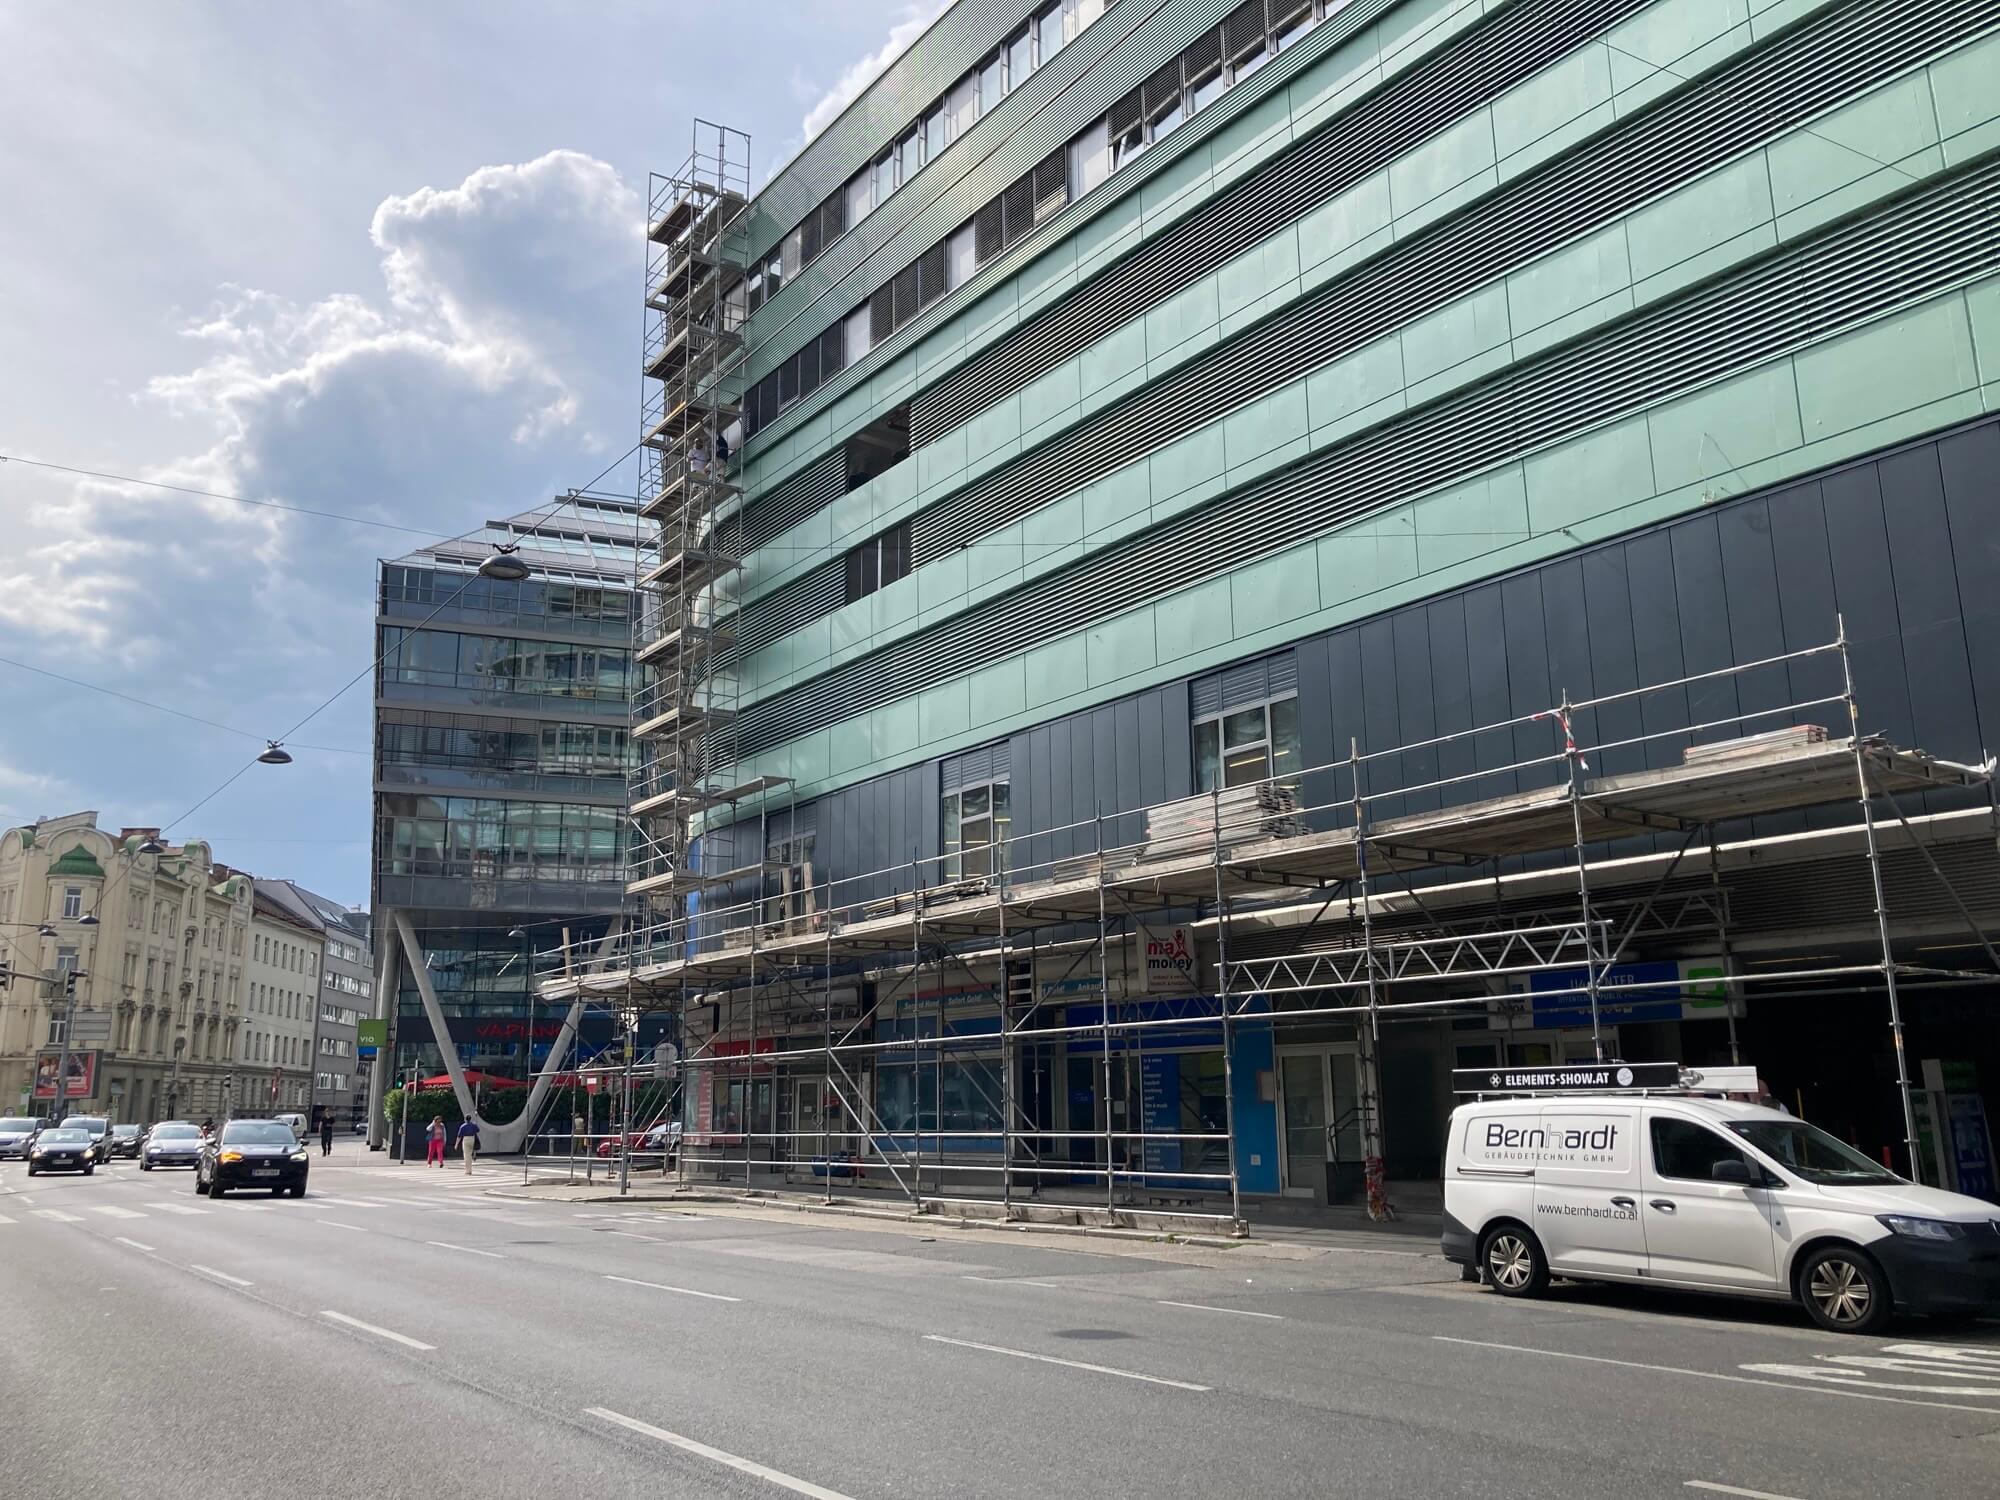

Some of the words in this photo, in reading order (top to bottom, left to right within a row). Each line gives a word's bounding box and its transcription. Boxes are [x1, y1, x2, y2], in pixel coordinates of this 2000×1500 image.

[476, 1022, 561, 1039] VAPIAN
[1505, 1072, 1610, 1086] ELEMENTS-SHOW.AT
[1485, 1123, 1618, 1150] Bernhardt
[1484, 1151, 1575, 1161] GEBÄUDETECHNIK
[1583, 1154, 1614, 1162] GMBH
[1537, 1204, 1638, 1221] www.bernhardt.co.at
